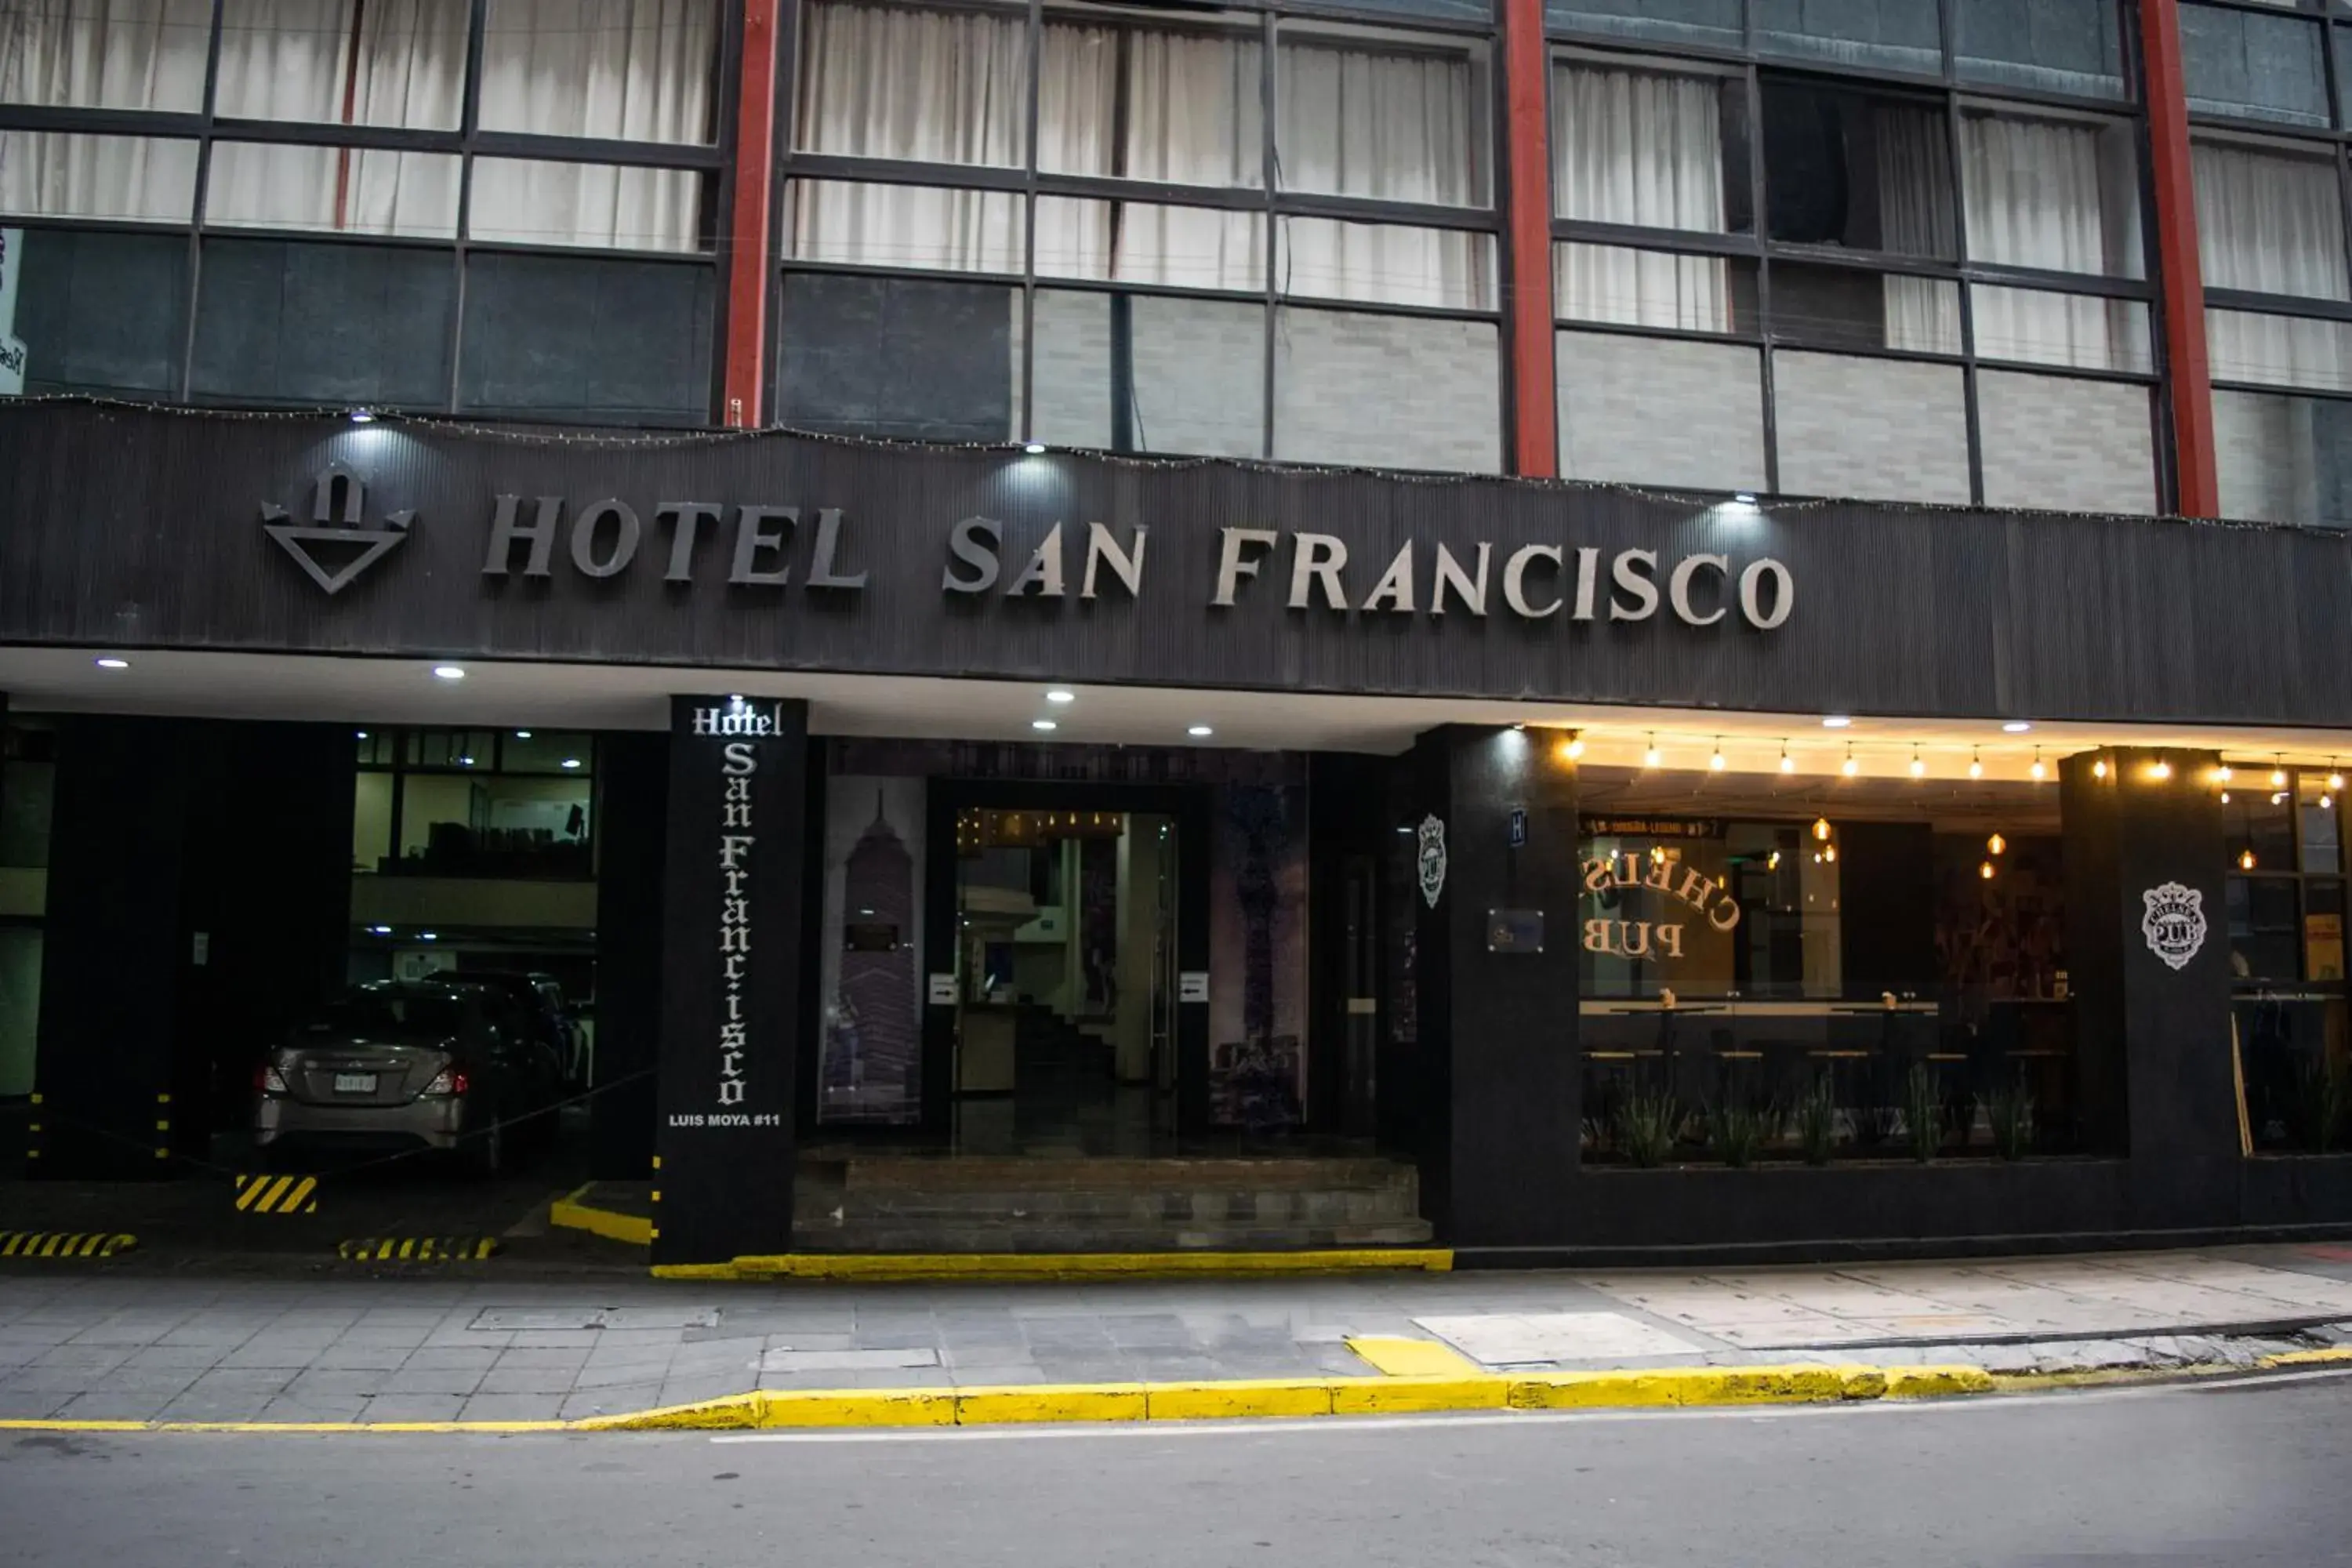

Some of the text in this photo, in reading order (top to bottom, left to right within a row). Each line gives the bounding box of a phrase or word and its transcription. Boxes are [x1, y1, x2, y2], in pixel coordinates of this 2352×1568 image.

[481, 494, 1795, 630] HOTEL SAN FRANCISCO
[692, 702, 783, 736] Hotel
[717, 742, 758, 1106] San Francisco
[2154, 924, 2198, 942] PUB
[669, 1114, 780, 1127] LUIS MOYA #11
